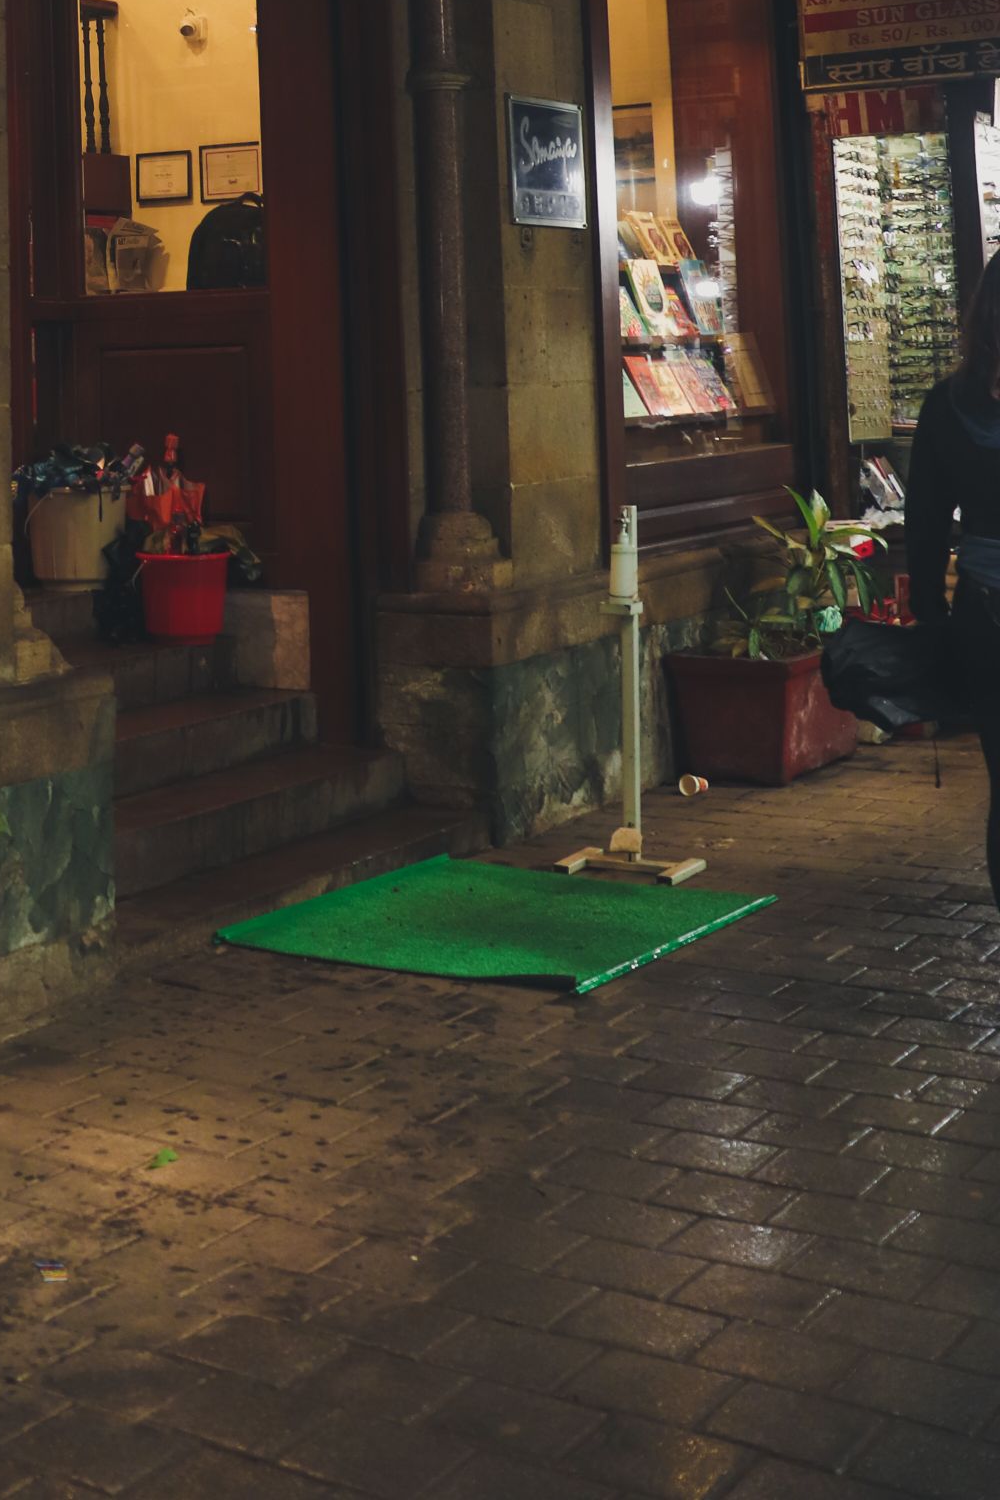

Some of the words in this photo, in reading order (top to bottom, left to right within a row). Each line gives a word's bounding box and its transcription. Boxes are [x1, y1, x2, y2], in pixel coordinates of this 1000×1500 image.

[856, 5, 905, 26] SUN
[848, 32, 874, 46] Rs.
[881, 27, 920, 43] 50/-
[925, 25, 952, 38] Rs.
[825, 58, 895, 83] स्टार
[824, 85, 938, 136] HMT
